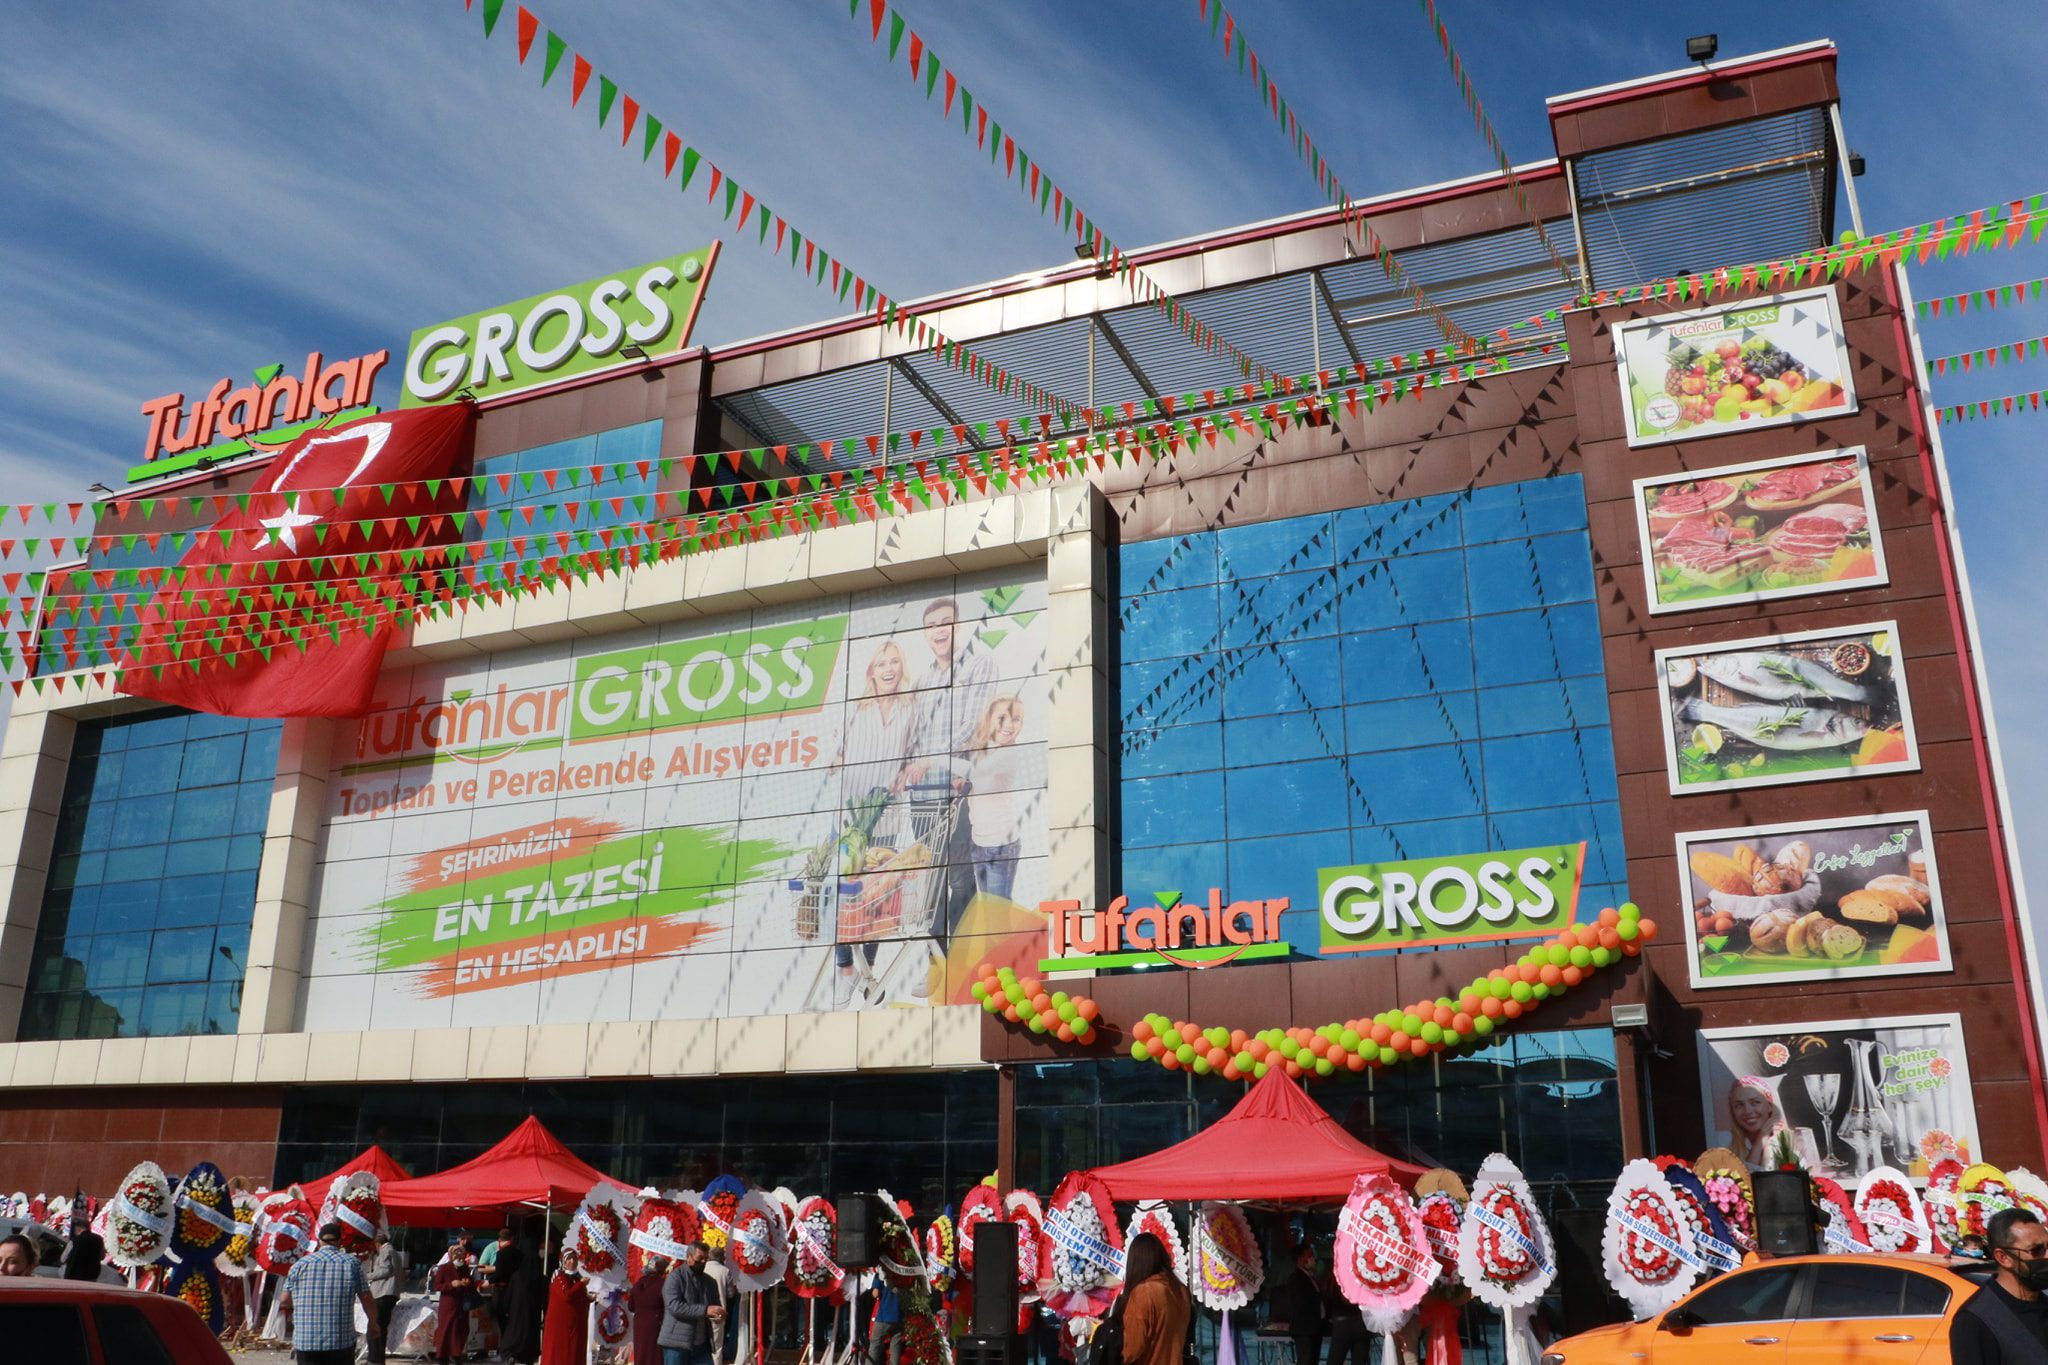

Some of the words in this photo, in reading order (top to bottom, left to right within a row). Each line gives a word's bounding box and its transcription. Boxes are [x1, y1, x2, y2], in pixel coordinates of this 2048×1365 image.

[141, 349, 389, 460] Tufanlar
[406, 266, 679, 401] GROSS
[357, 683, 569, 758] Tufanlar
[578, 636, 815, 726] GROSS
[341, 782, 436, 820] Toptan
[446, 778, 478, 804] ve
[487, 751, 655, 799] Perakende
[665, 730, 819, 778] Alışveriş
[439, 825, 572, 882] ŞEHRİMİZİN
[433, 894, 494, 942] EN
[504, 841, 665, 925] TAZESİ
[1039, 887, 1290, 954] Tufanlar
[1322, 857, 1558, 936] GROSS
[455, 954, 494, 985] EN
[499, 925, 648, 977] HESAPLISI
[1883, 1048, 1938, 1067] Evinize
[1896, 1063, 1928, 1080] dair
[1885, 1082, 1911, 1095] her
[1201, 1235, 1234, 1265] KUVEYT
[1474, 1207, 1507, 1230] MESUT
[1506, 1224, 1518, 1239] 71
